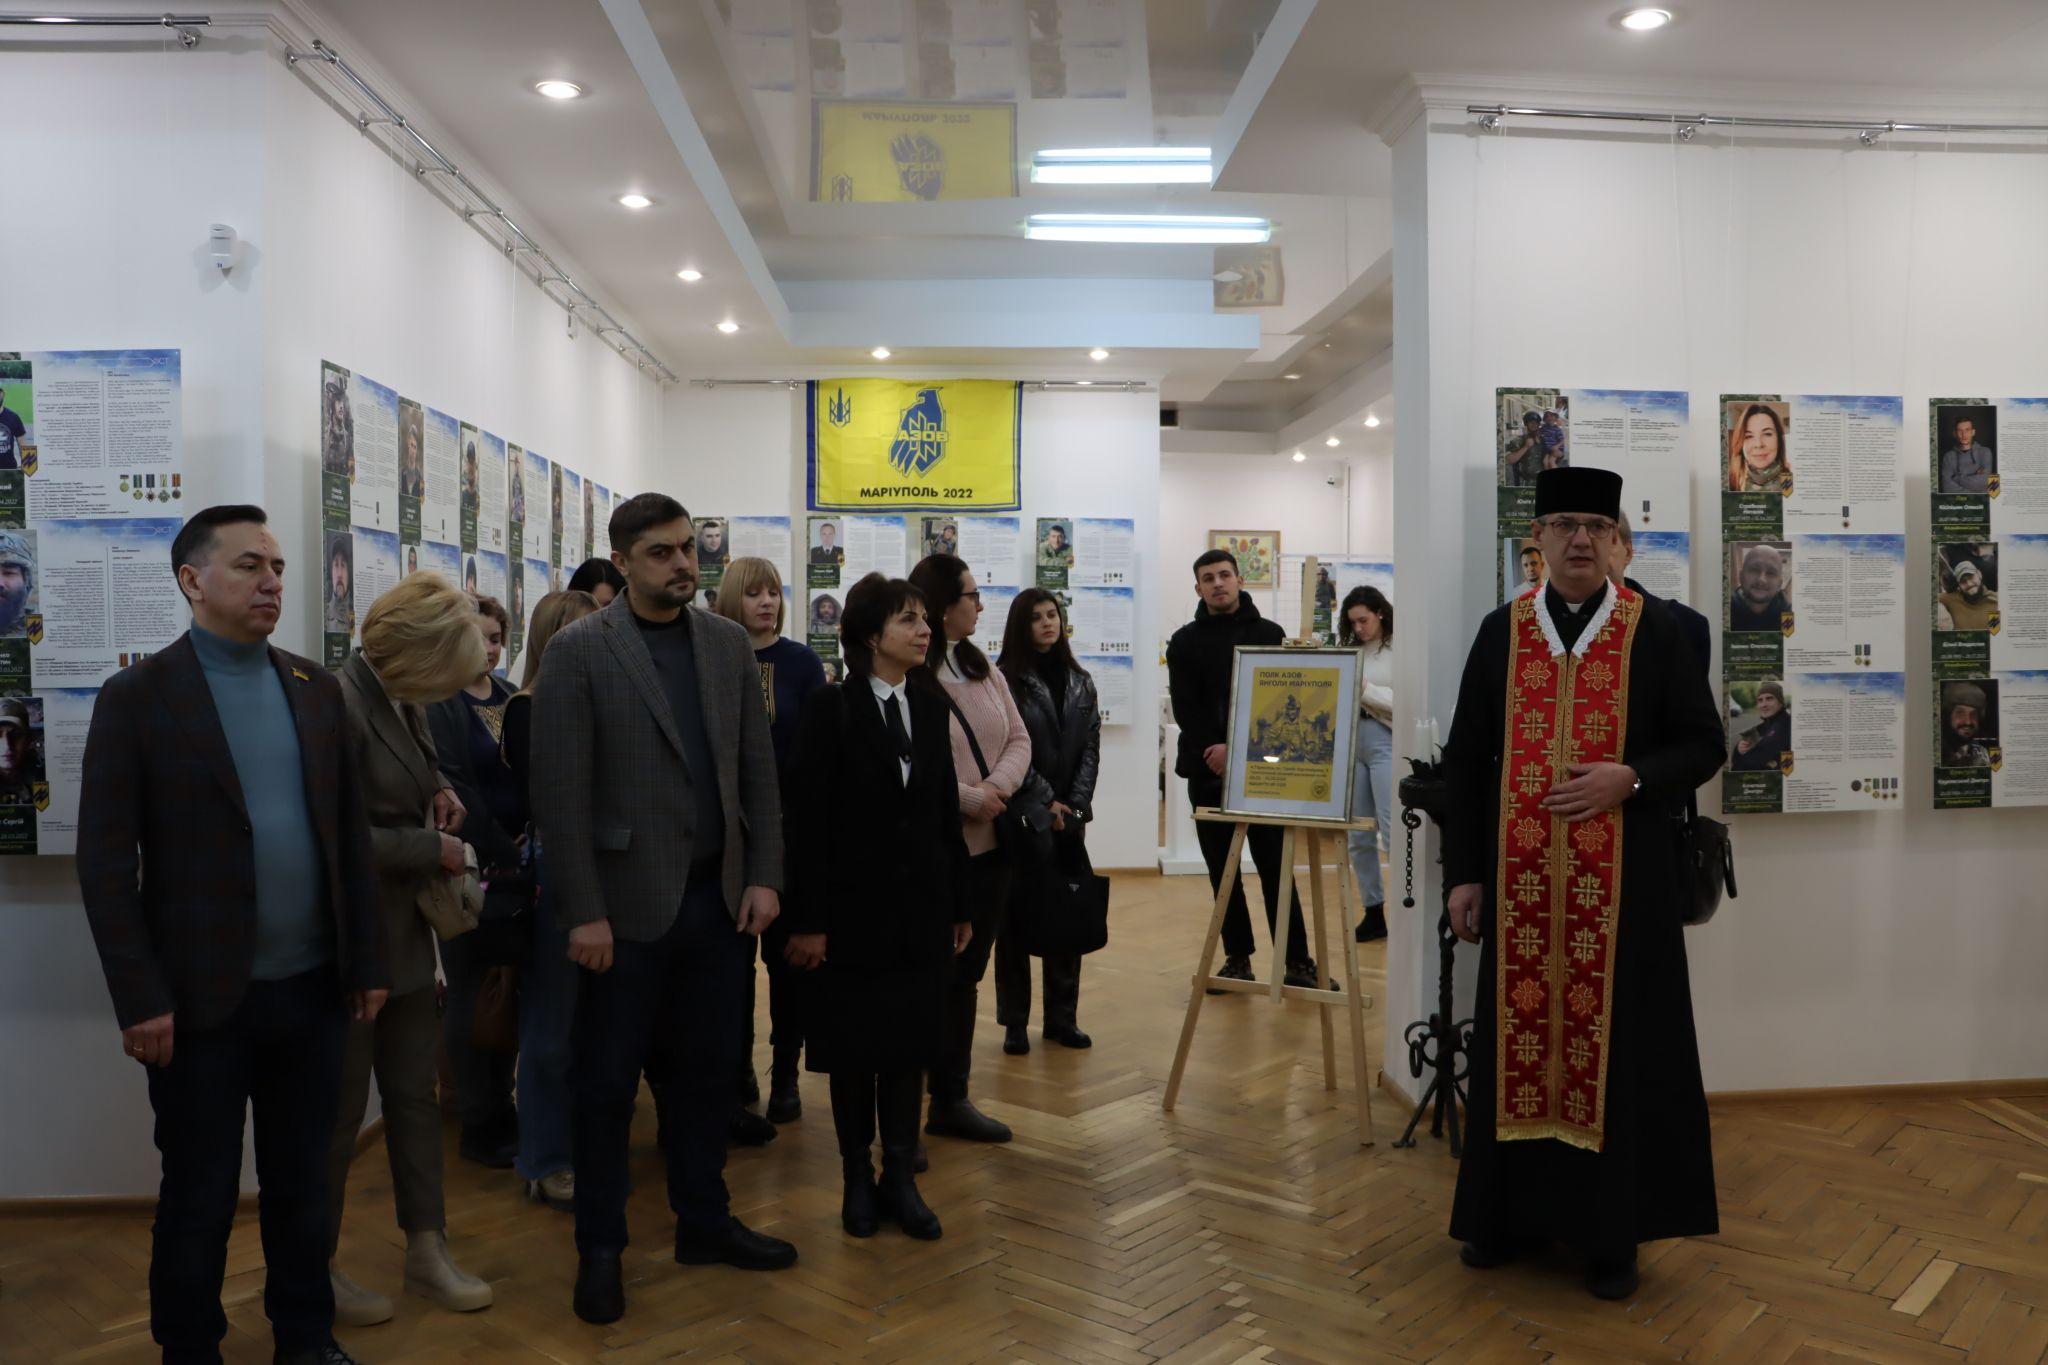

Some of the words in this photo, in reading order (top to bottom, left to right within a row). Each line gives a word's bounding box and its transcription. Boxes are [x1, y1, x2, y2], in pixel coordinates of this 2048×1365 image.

[897, 429, 949, 442] АЗОВ
[860, 486, 938, 498] МАРІУПОЛЬ
[943, 488, 973, 498] 2022
[1259, 671, 1280, 679] ПОЛК
[1282, 671, 1302, 679] АЗОВ
